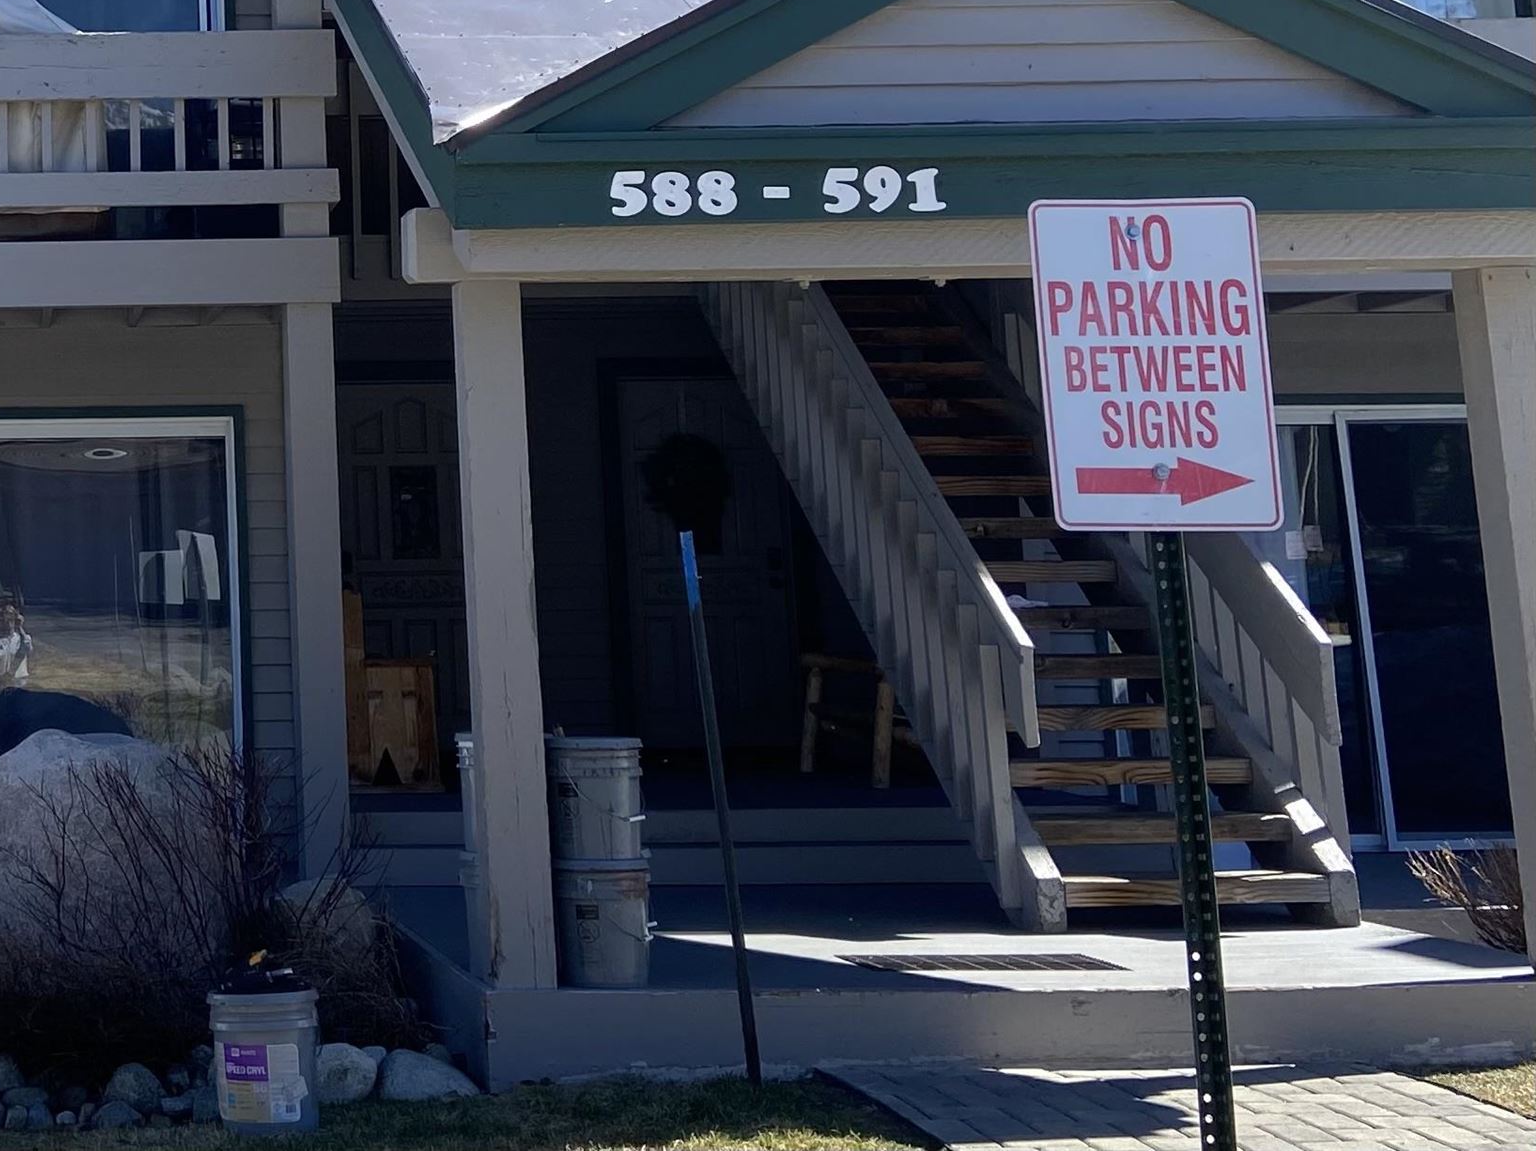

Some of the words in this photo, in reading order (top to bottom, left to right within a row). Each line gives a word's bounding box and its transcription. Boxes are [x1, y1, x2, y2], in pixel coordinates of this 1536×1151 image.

[610, 170, 738, 217] 588
[763, 186, 791, 199] -
[822, 165, 947, 214] 591
[1109, 214, 1172, 272] NO
[1047, 278, 1251, 337] PARKING
[1064, 345, 1246, 393] BETWEEN
[1101, 400, 1219, 449] SIGNS
